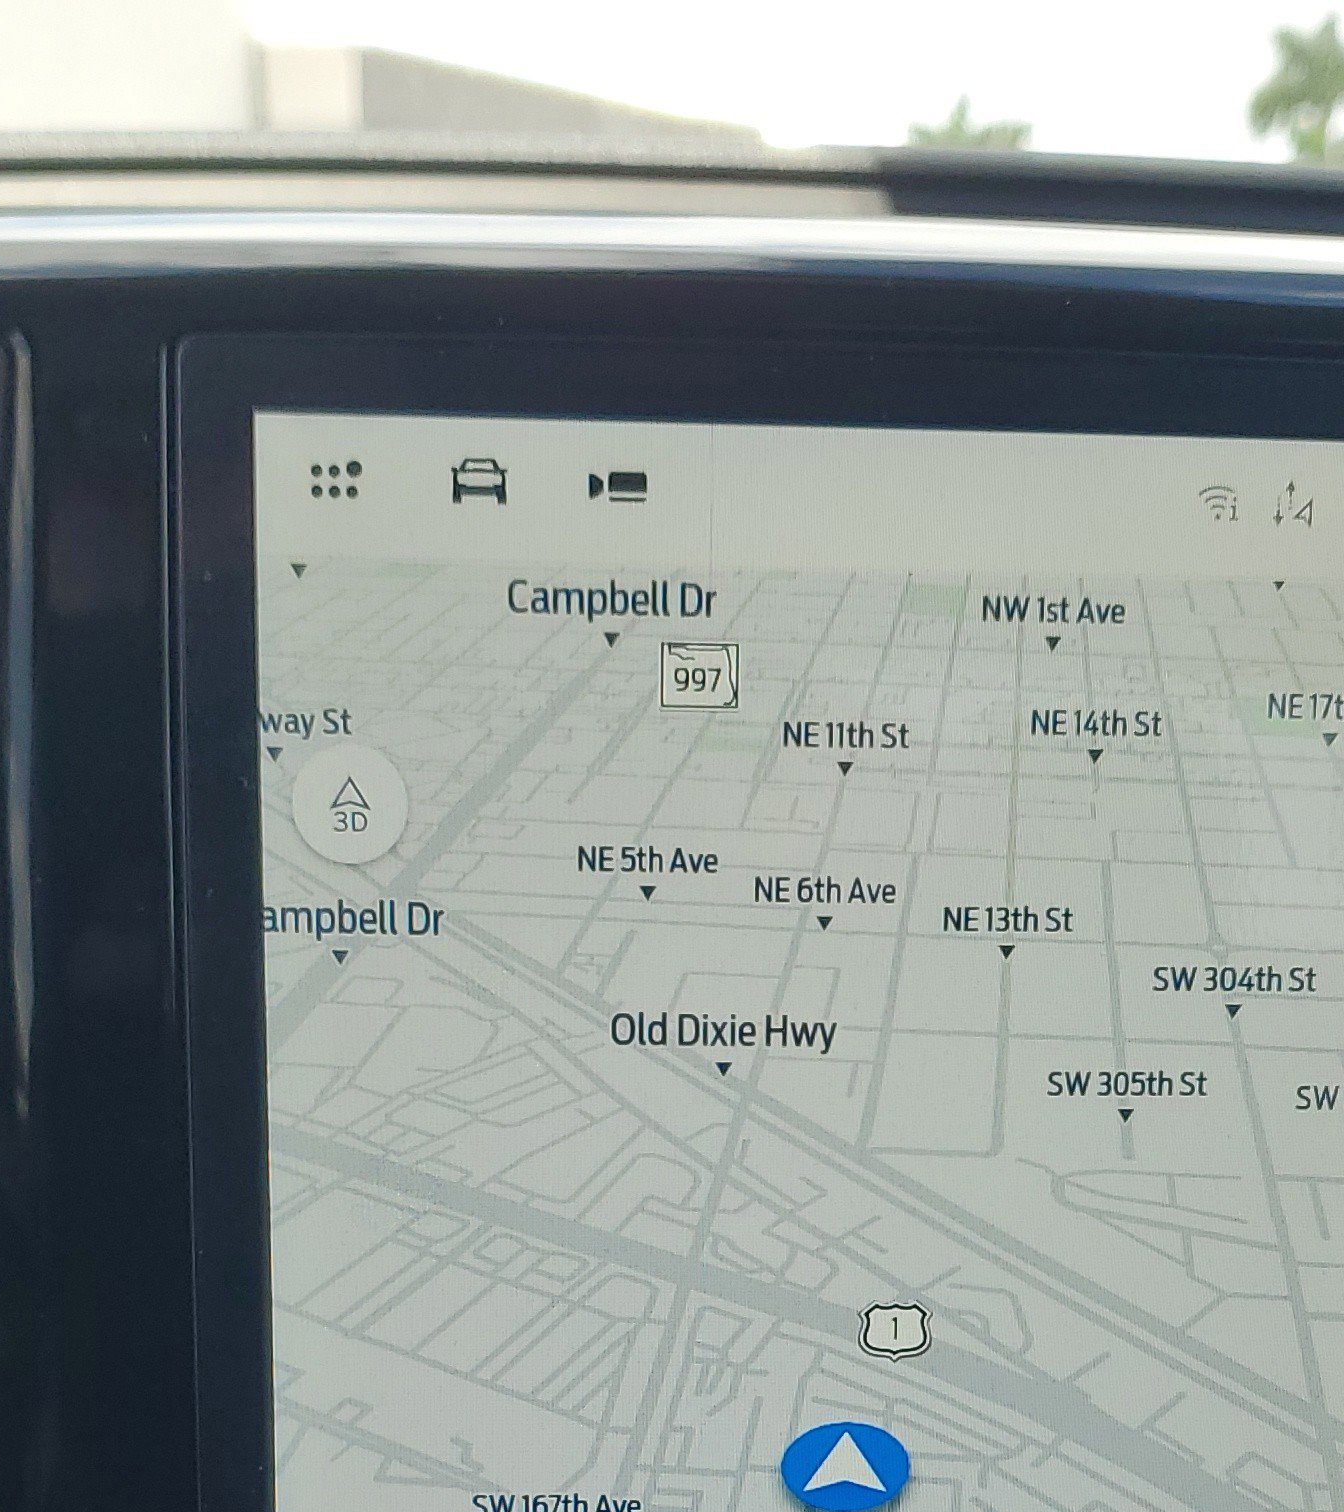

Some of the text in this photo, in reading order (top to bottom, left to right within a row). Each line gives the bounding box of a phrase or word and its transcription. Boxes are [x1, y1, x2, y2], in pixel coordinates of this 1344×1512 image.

[507, 579, 718, 624] Campbell Dr
[981, 595, 1126, 624] NW 1st Ave
[673, 667, 722, 692] 997
[1267, 692, 1304, 719] NE
[322, 708, 352, 735] St
[783, 721, 910, 749] NE 11th St
[1031, 709, 1162, 737] NE 14th St
[332, 811, 369, 834] 3D
[577, 846, 718, 874] NE 5th Ave
[754, 876, 896, 904] NE 6th Ave
[408, 901, 445, 936] Dr
[943, 906, 1073, 932] NE 13th St
[1152, 966, 1317, 992] SW 304th St
[610, 1012, 838, 1054] Old Dixie Hwy
[1047, 1071, 1208, 1097] SW 305th St
[1295, 1085, 1339, 1110] SW
[890, 1316, 900, 1342] 1
